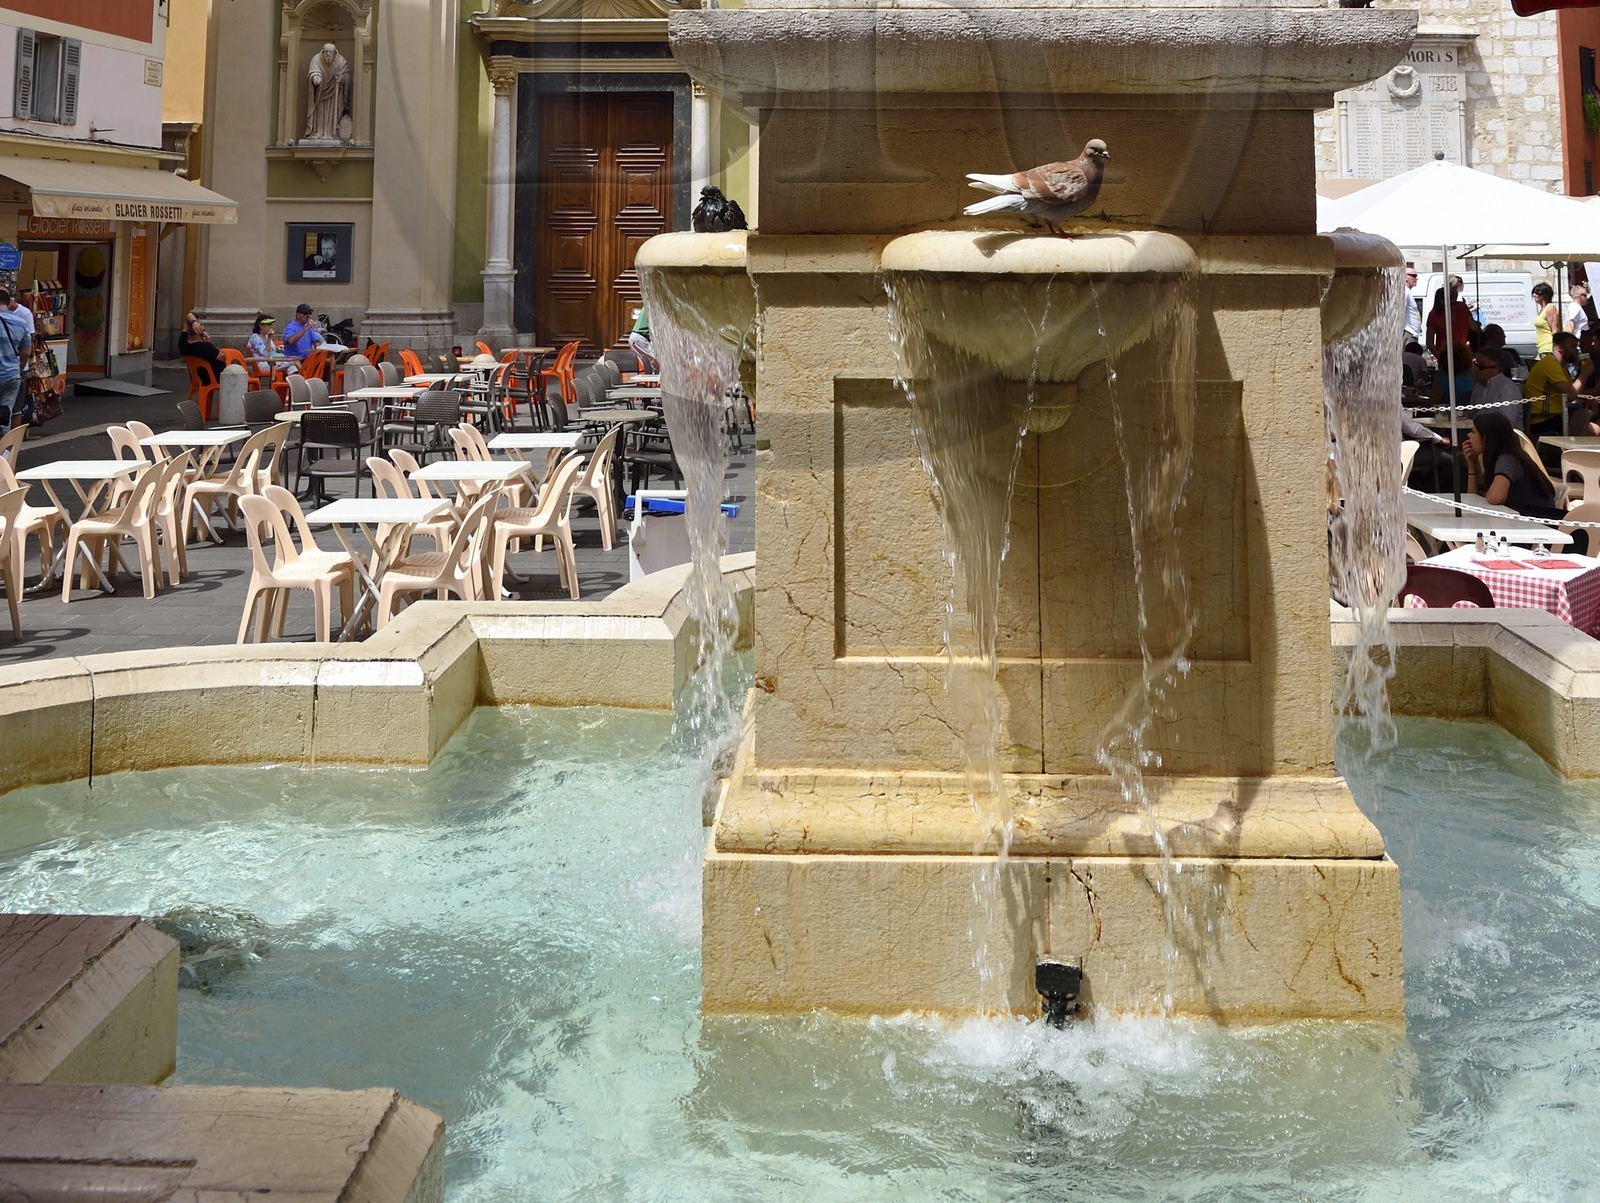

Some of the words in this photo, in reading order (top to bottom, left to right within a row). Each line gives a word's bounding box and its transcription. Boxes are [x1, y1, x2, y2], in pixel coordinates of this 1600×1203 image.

[115, 203, 147, 218] GLACIER
[150, 205, 183, 220] ROSSETTI
[28, 215, 69, 234] Glacier
